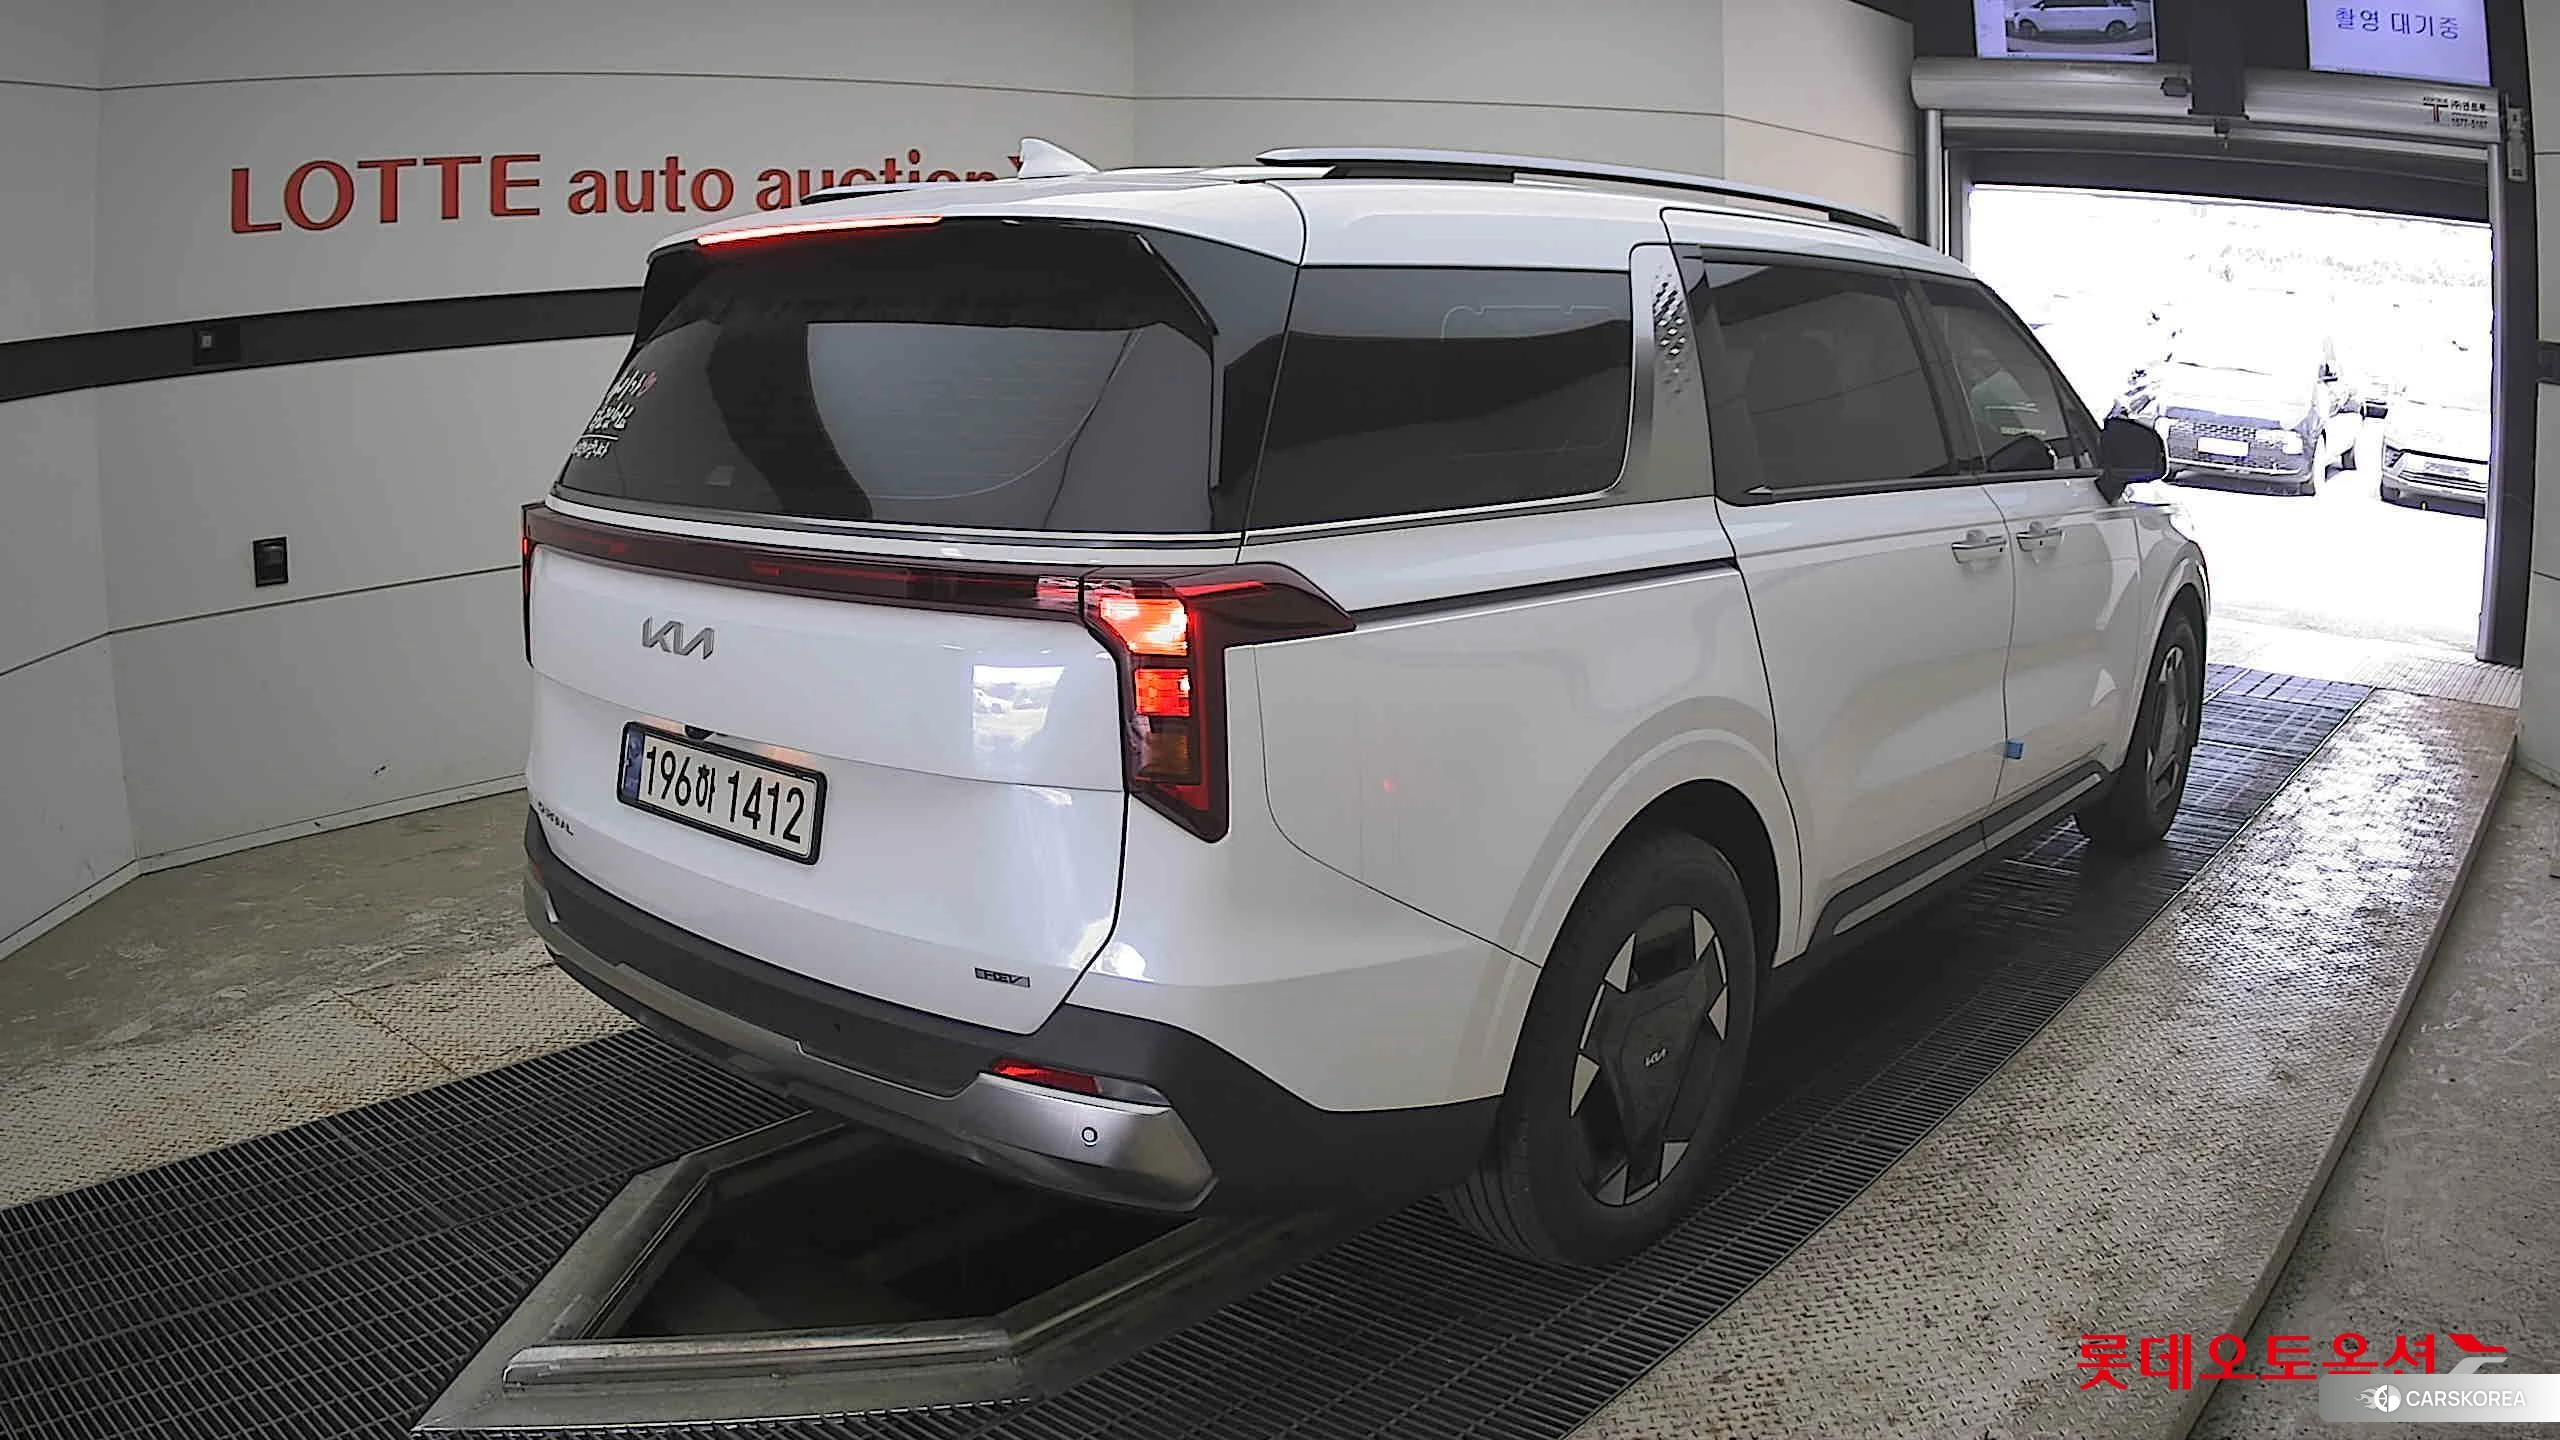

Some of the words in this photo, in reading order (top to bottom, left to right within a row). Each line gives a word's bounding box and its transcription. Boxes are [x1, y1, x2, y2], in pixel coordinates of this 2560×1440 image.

[2391, 12, 2458, 40] 대기중
[231, 153, 542, 234] LOTTE
[567, 152, 735, 215] auto
[646, 745, 716, 814] 196하
[727, 769, 805, 844] 1412
